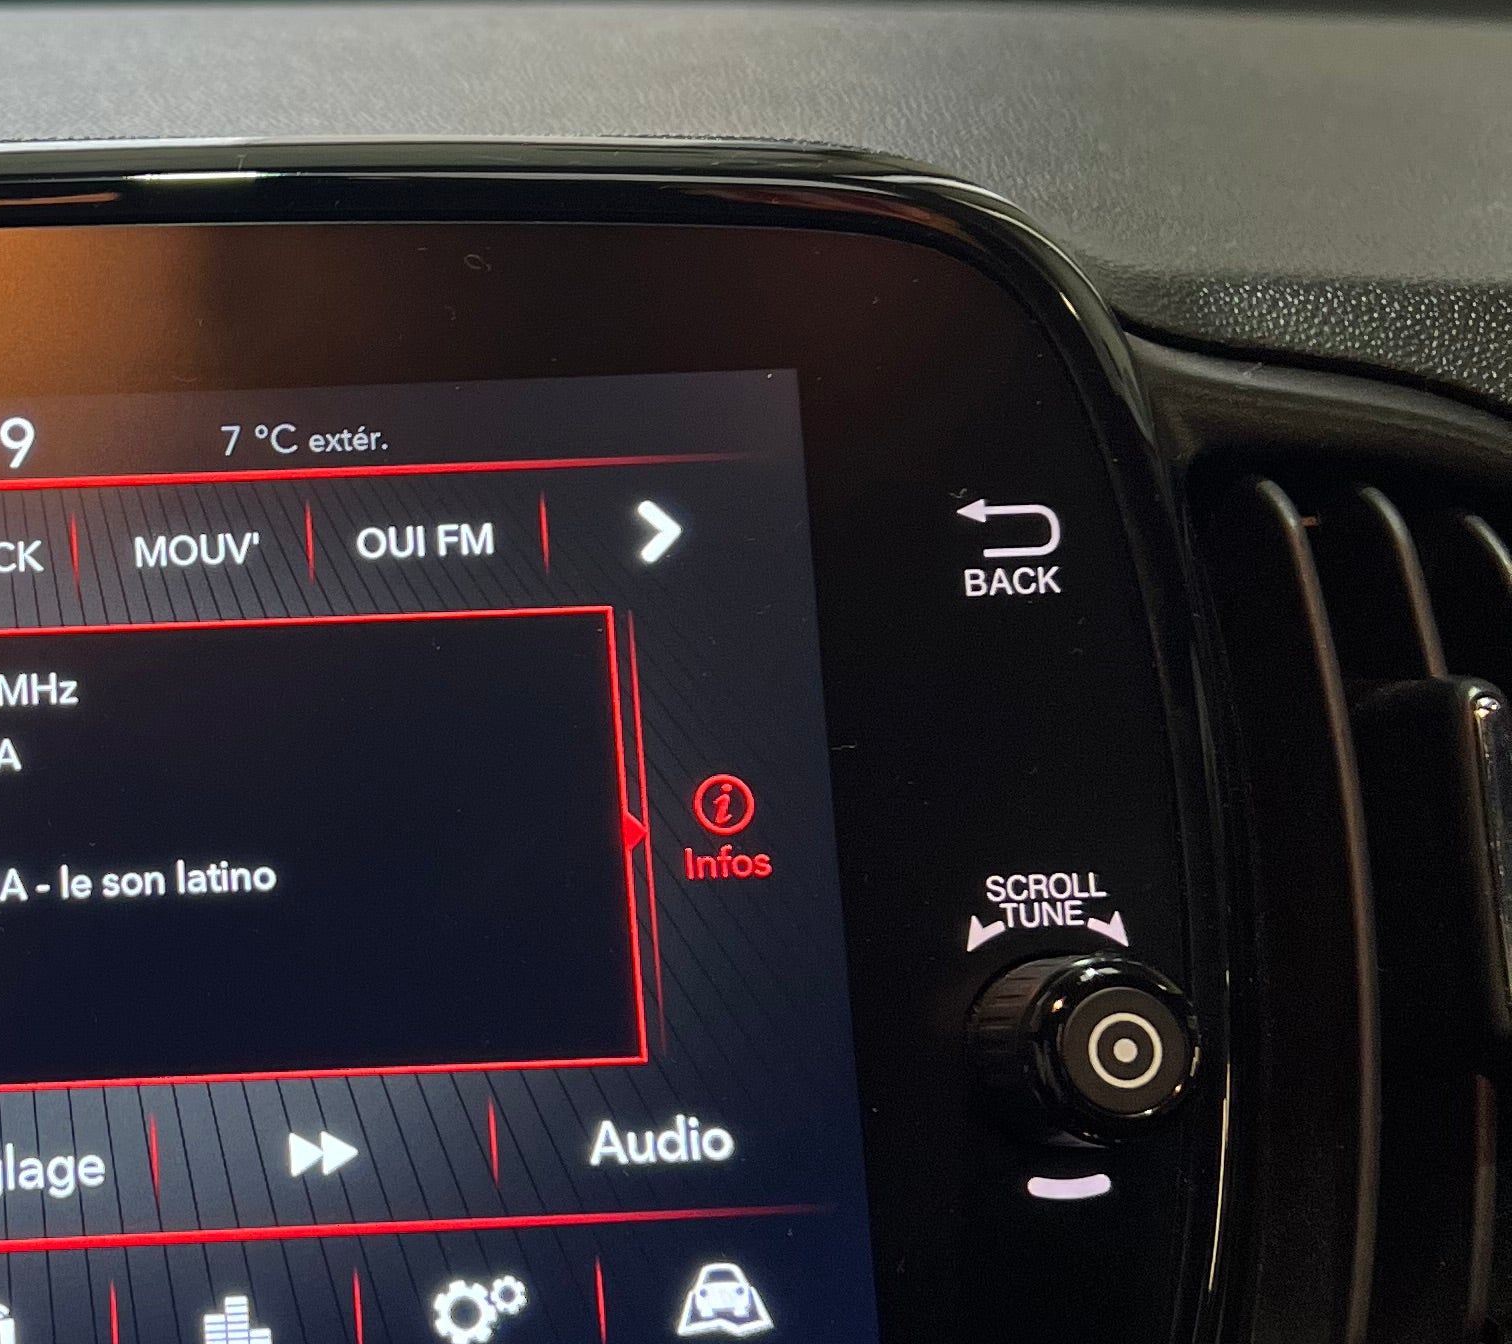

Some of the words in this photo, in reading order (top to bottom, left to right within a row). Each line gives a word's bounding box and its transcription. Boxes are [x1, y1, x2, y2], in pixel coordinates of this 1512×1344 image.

[219, 424, 242, 457] 7
[307, 424, 389, 454] extér.
[133, 531, 261, 569] MOUV'
[355, 524, 427, 560] OUI
[436, 521, 495, 558] FM
[963, 565, 1062, 598] BACK
[59, 863, 94, 900] le
[101, 870, 167, 899] son
[175, 858, 278, 895] latino
[683, 843, 774, 882] Infos
[984, 870, 1108, 904] SCROLL
[998, 899, 1086, 930] TUNE
[588, 1113, 735, 1167] Audio
